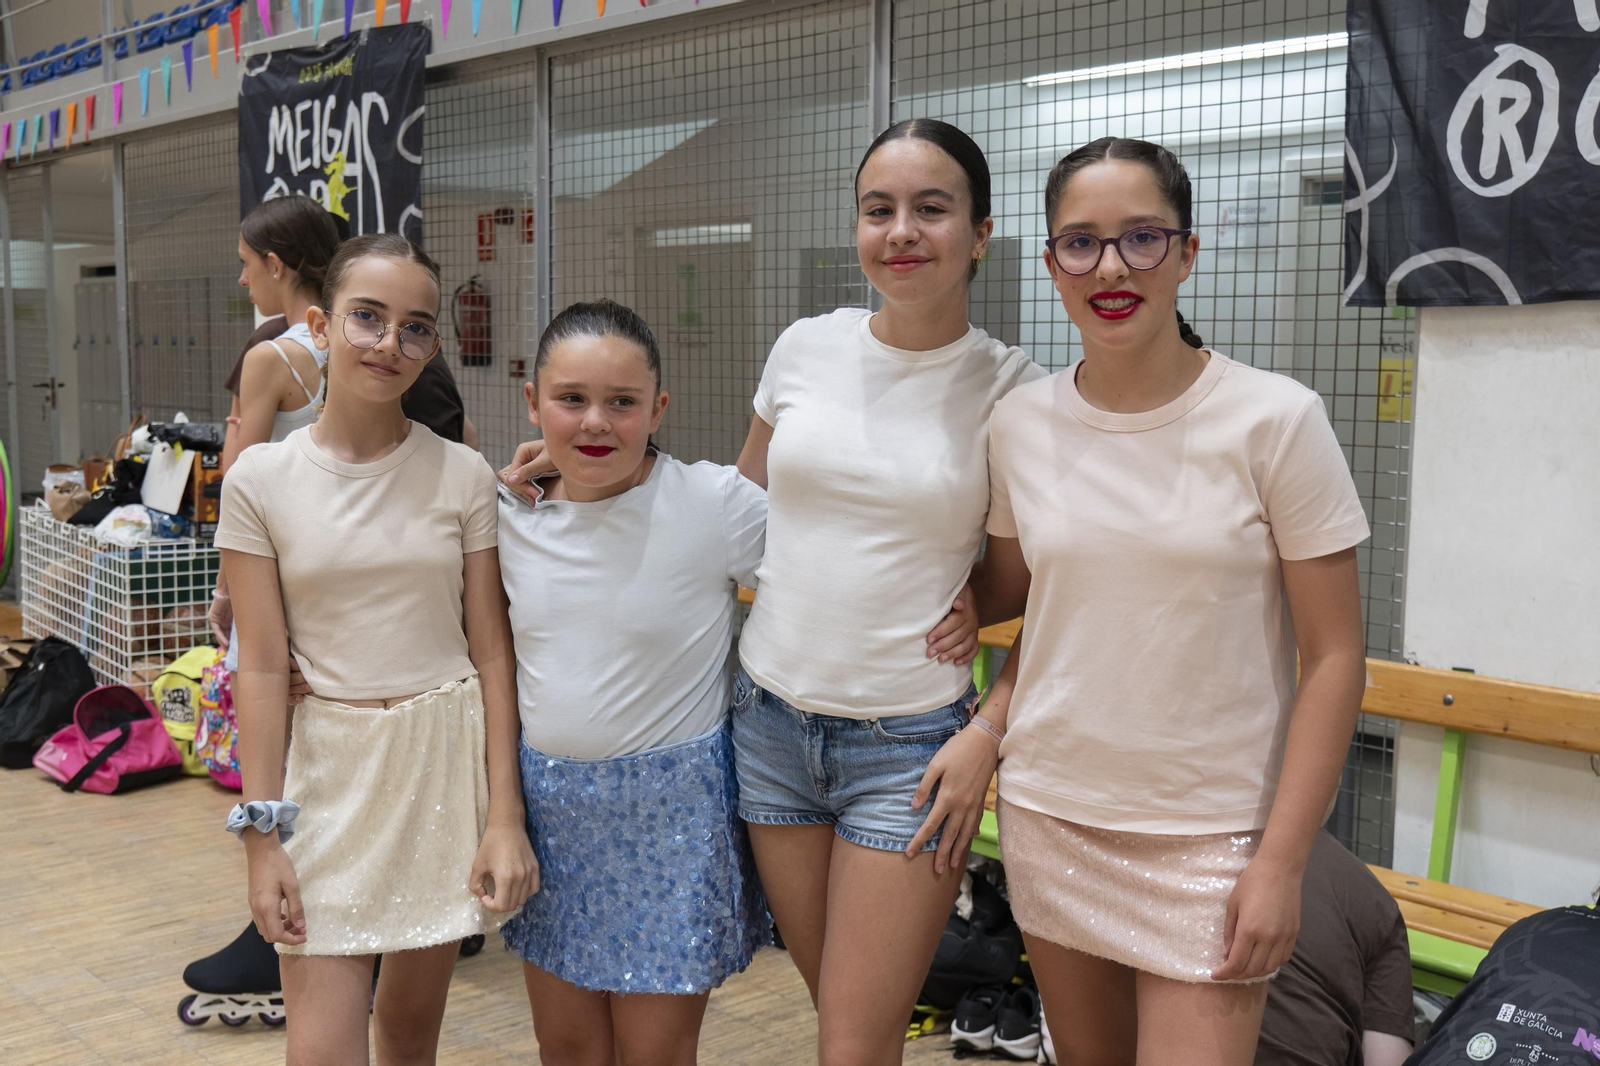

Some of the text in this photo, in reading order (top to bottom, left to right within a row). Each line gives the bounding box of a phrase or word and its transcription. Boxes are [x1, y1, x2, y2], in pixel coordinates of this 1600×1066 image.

[1516, 1008, 1547, 1023] XUNTA
[1513, 1015, 1563, 1039] DE GALICIA
